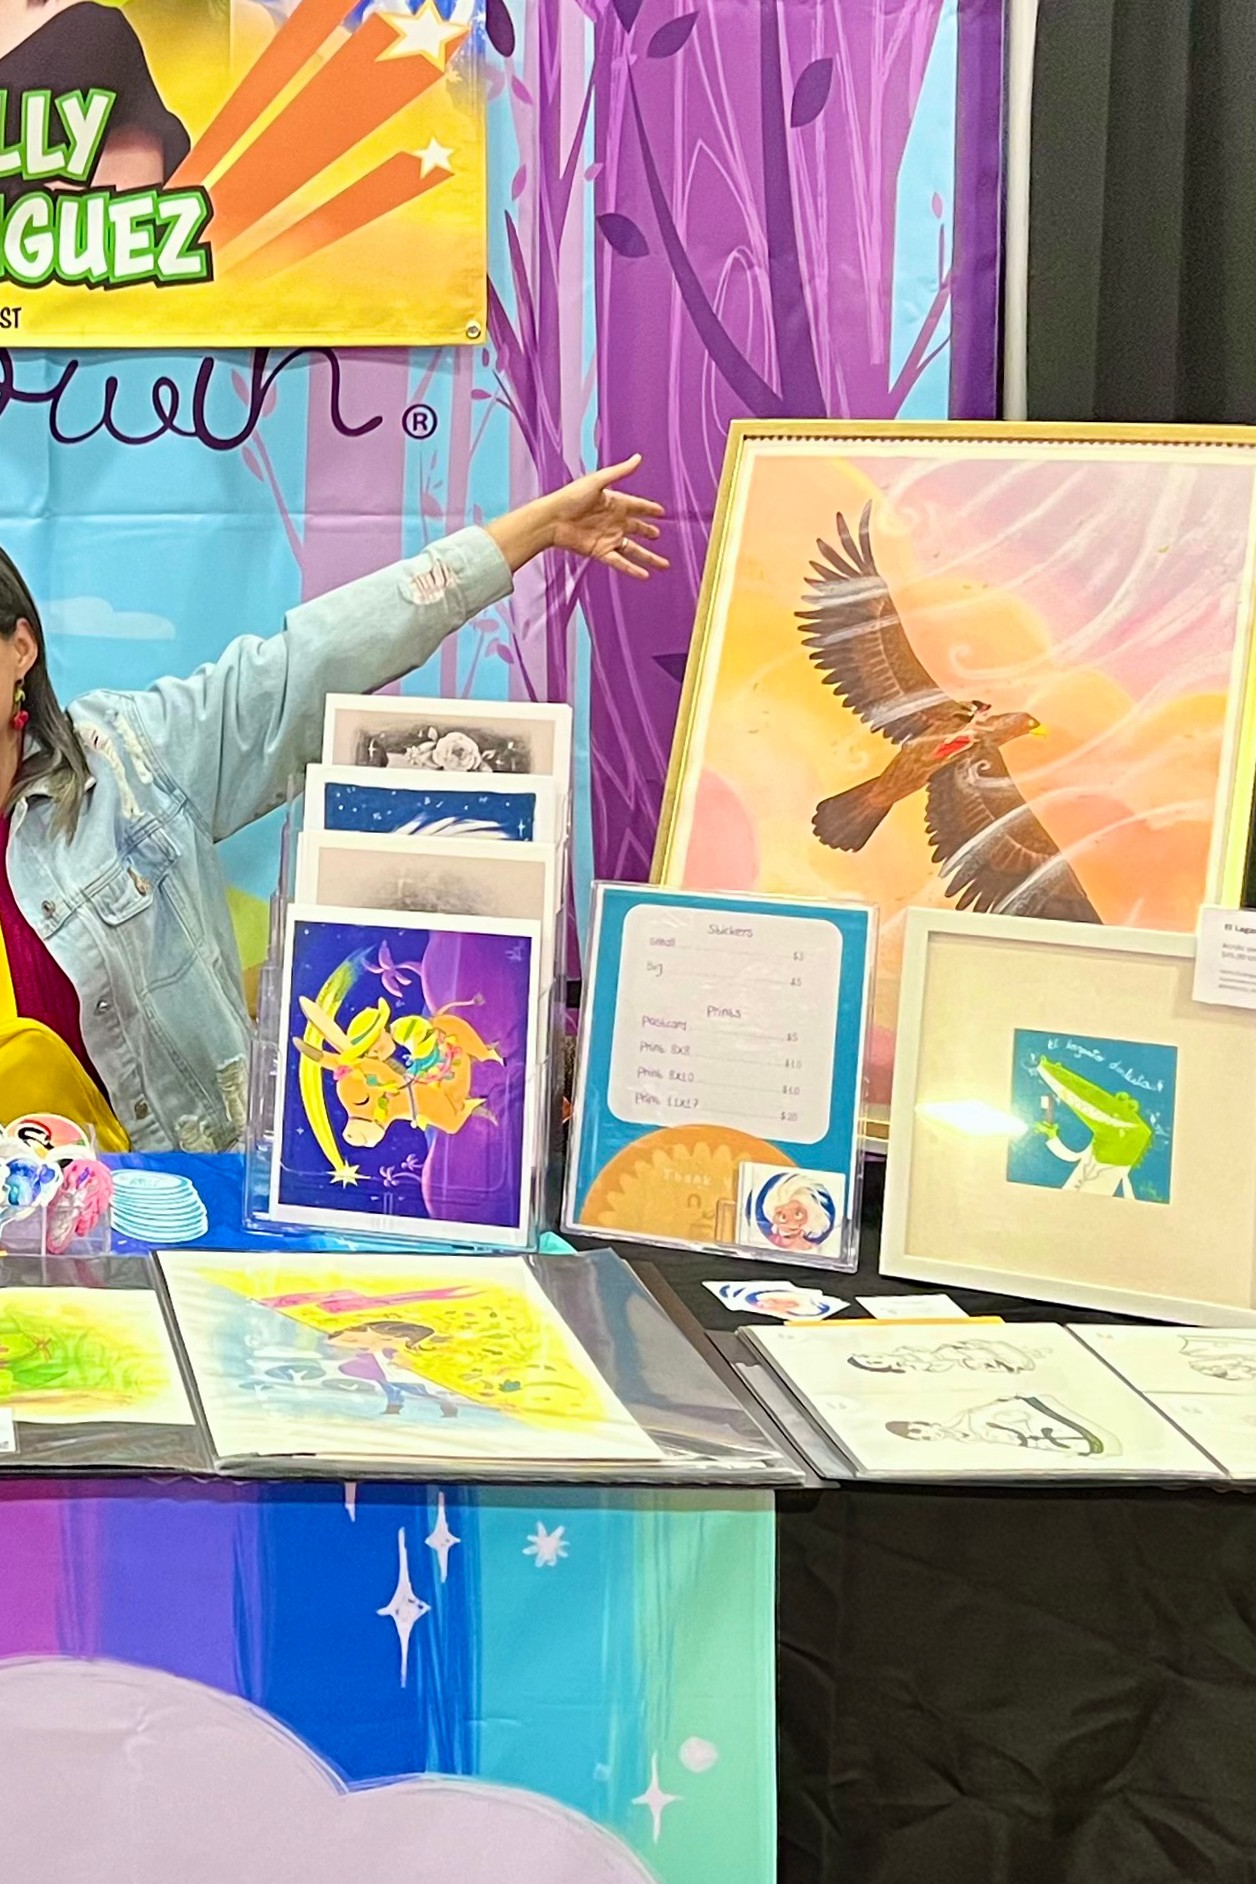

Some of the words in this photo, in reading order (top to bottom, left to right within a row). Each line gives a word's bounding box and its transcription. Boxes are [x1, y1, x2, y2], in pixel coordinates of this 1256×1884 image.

[707, 924, 754, 938] Stickers
[646, 961, 663, 977] Big
[706, 1004, 742, 1018] Prints
[780, 1111, 798, 1122] $20
